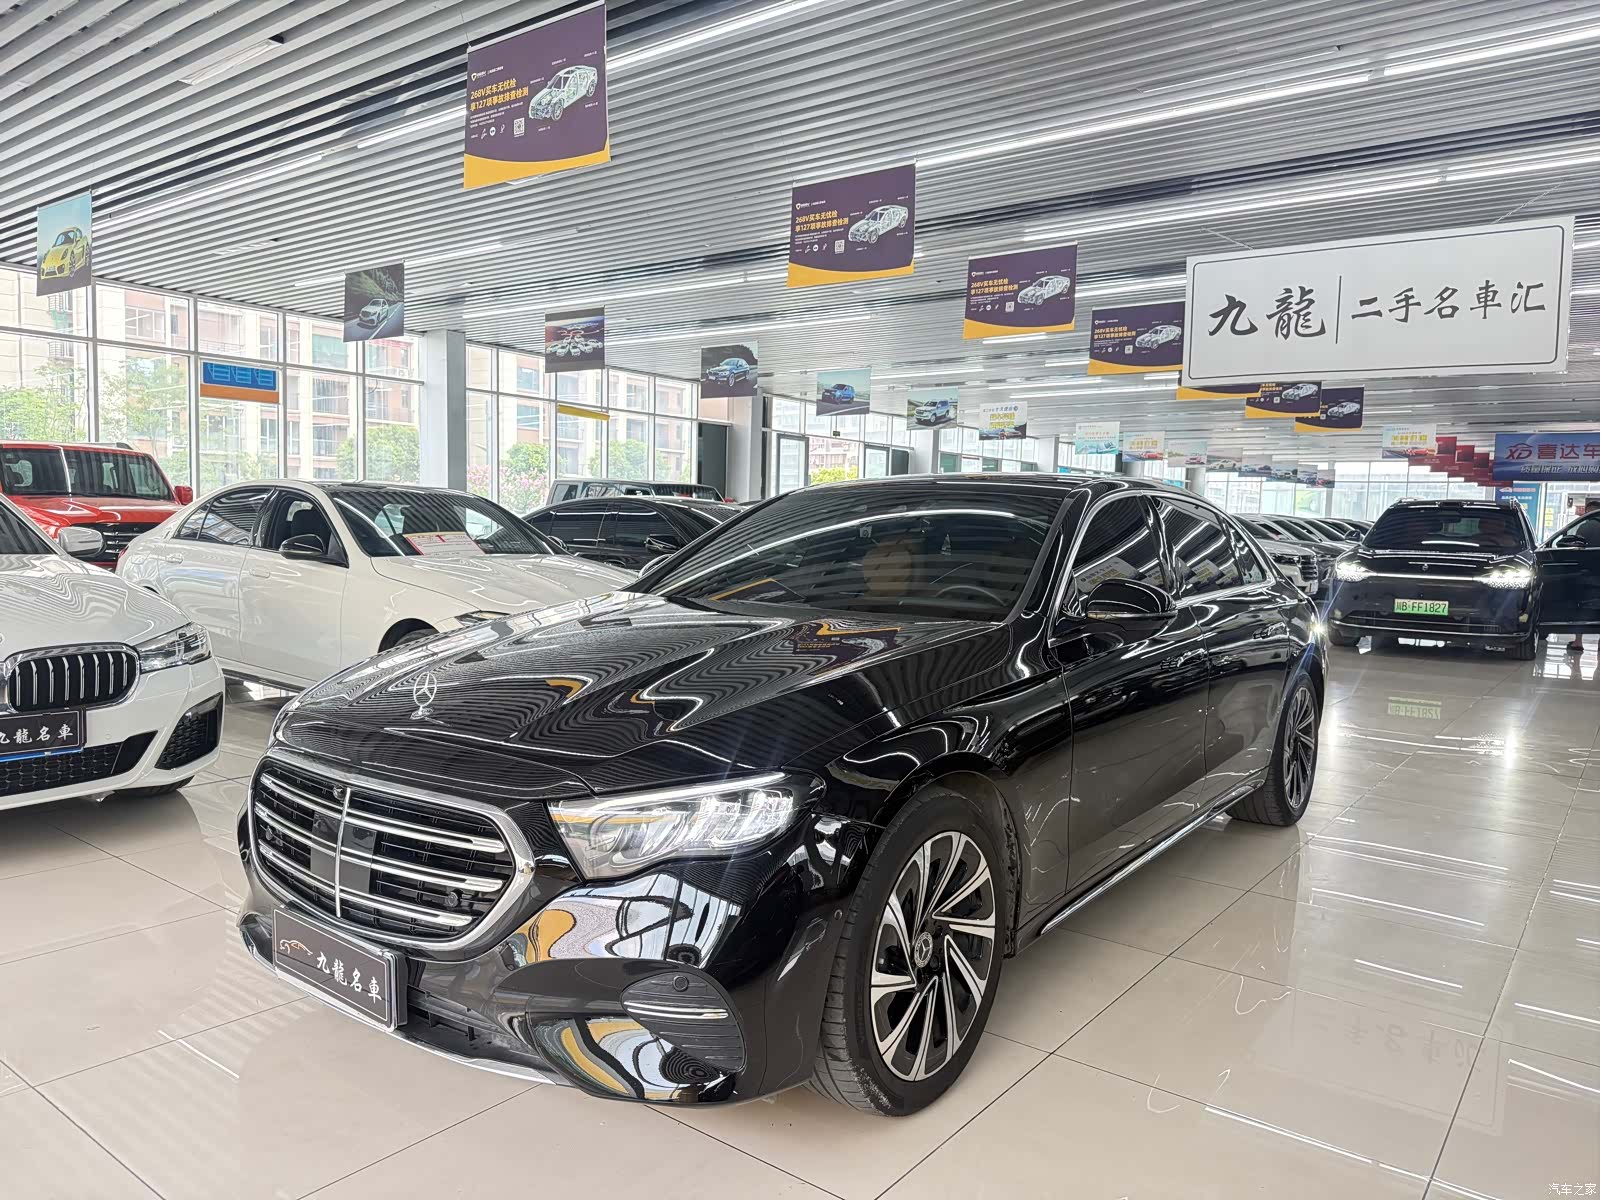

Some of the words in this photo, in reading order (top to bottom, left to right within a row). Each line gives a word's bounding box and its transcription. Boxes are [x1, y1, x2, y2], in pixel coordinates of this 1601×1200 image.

[1208, 285, 1326, 341] 九龍
[1351, 279, 1546, 323] 二手名車汇
[316, 951, 382, 1004] 九龍名車
